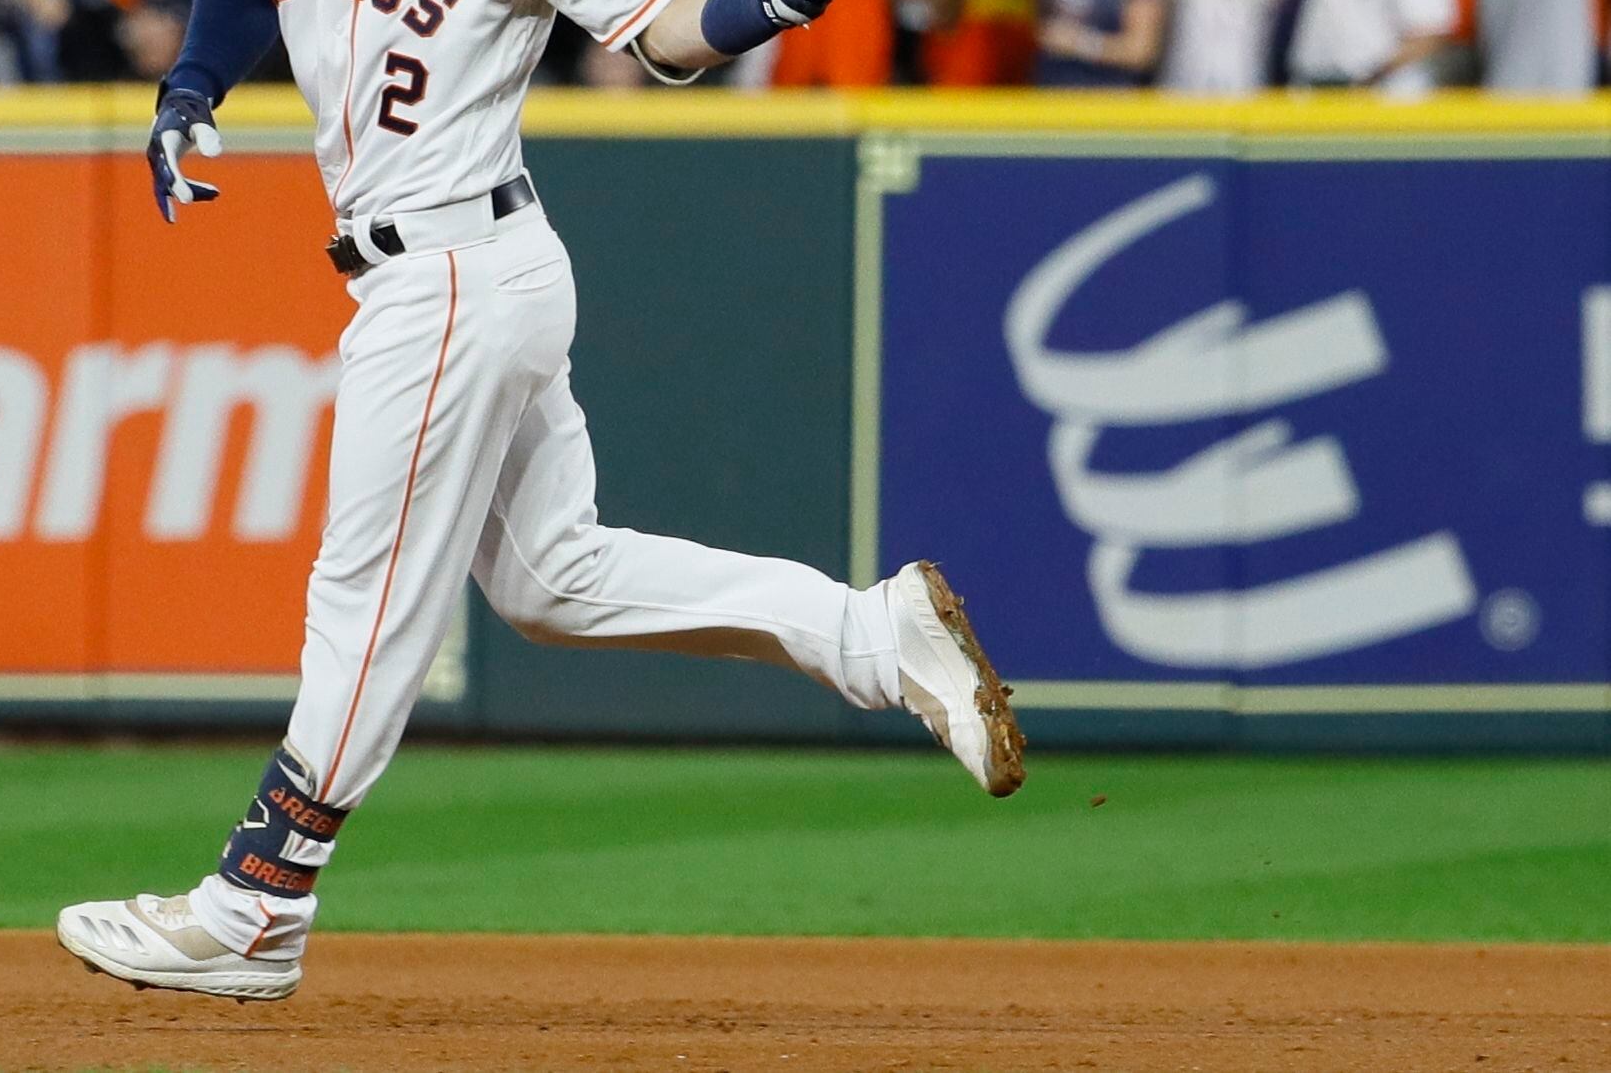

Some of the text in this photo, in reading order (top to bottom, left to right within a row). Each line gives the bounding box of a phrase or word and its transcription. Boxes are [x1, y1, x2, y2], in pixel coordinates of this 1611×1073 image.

[377, 50, 430, 137] 2
[268, 787, 338, 835] BREG
[239, 853, 310, 891] BREG
